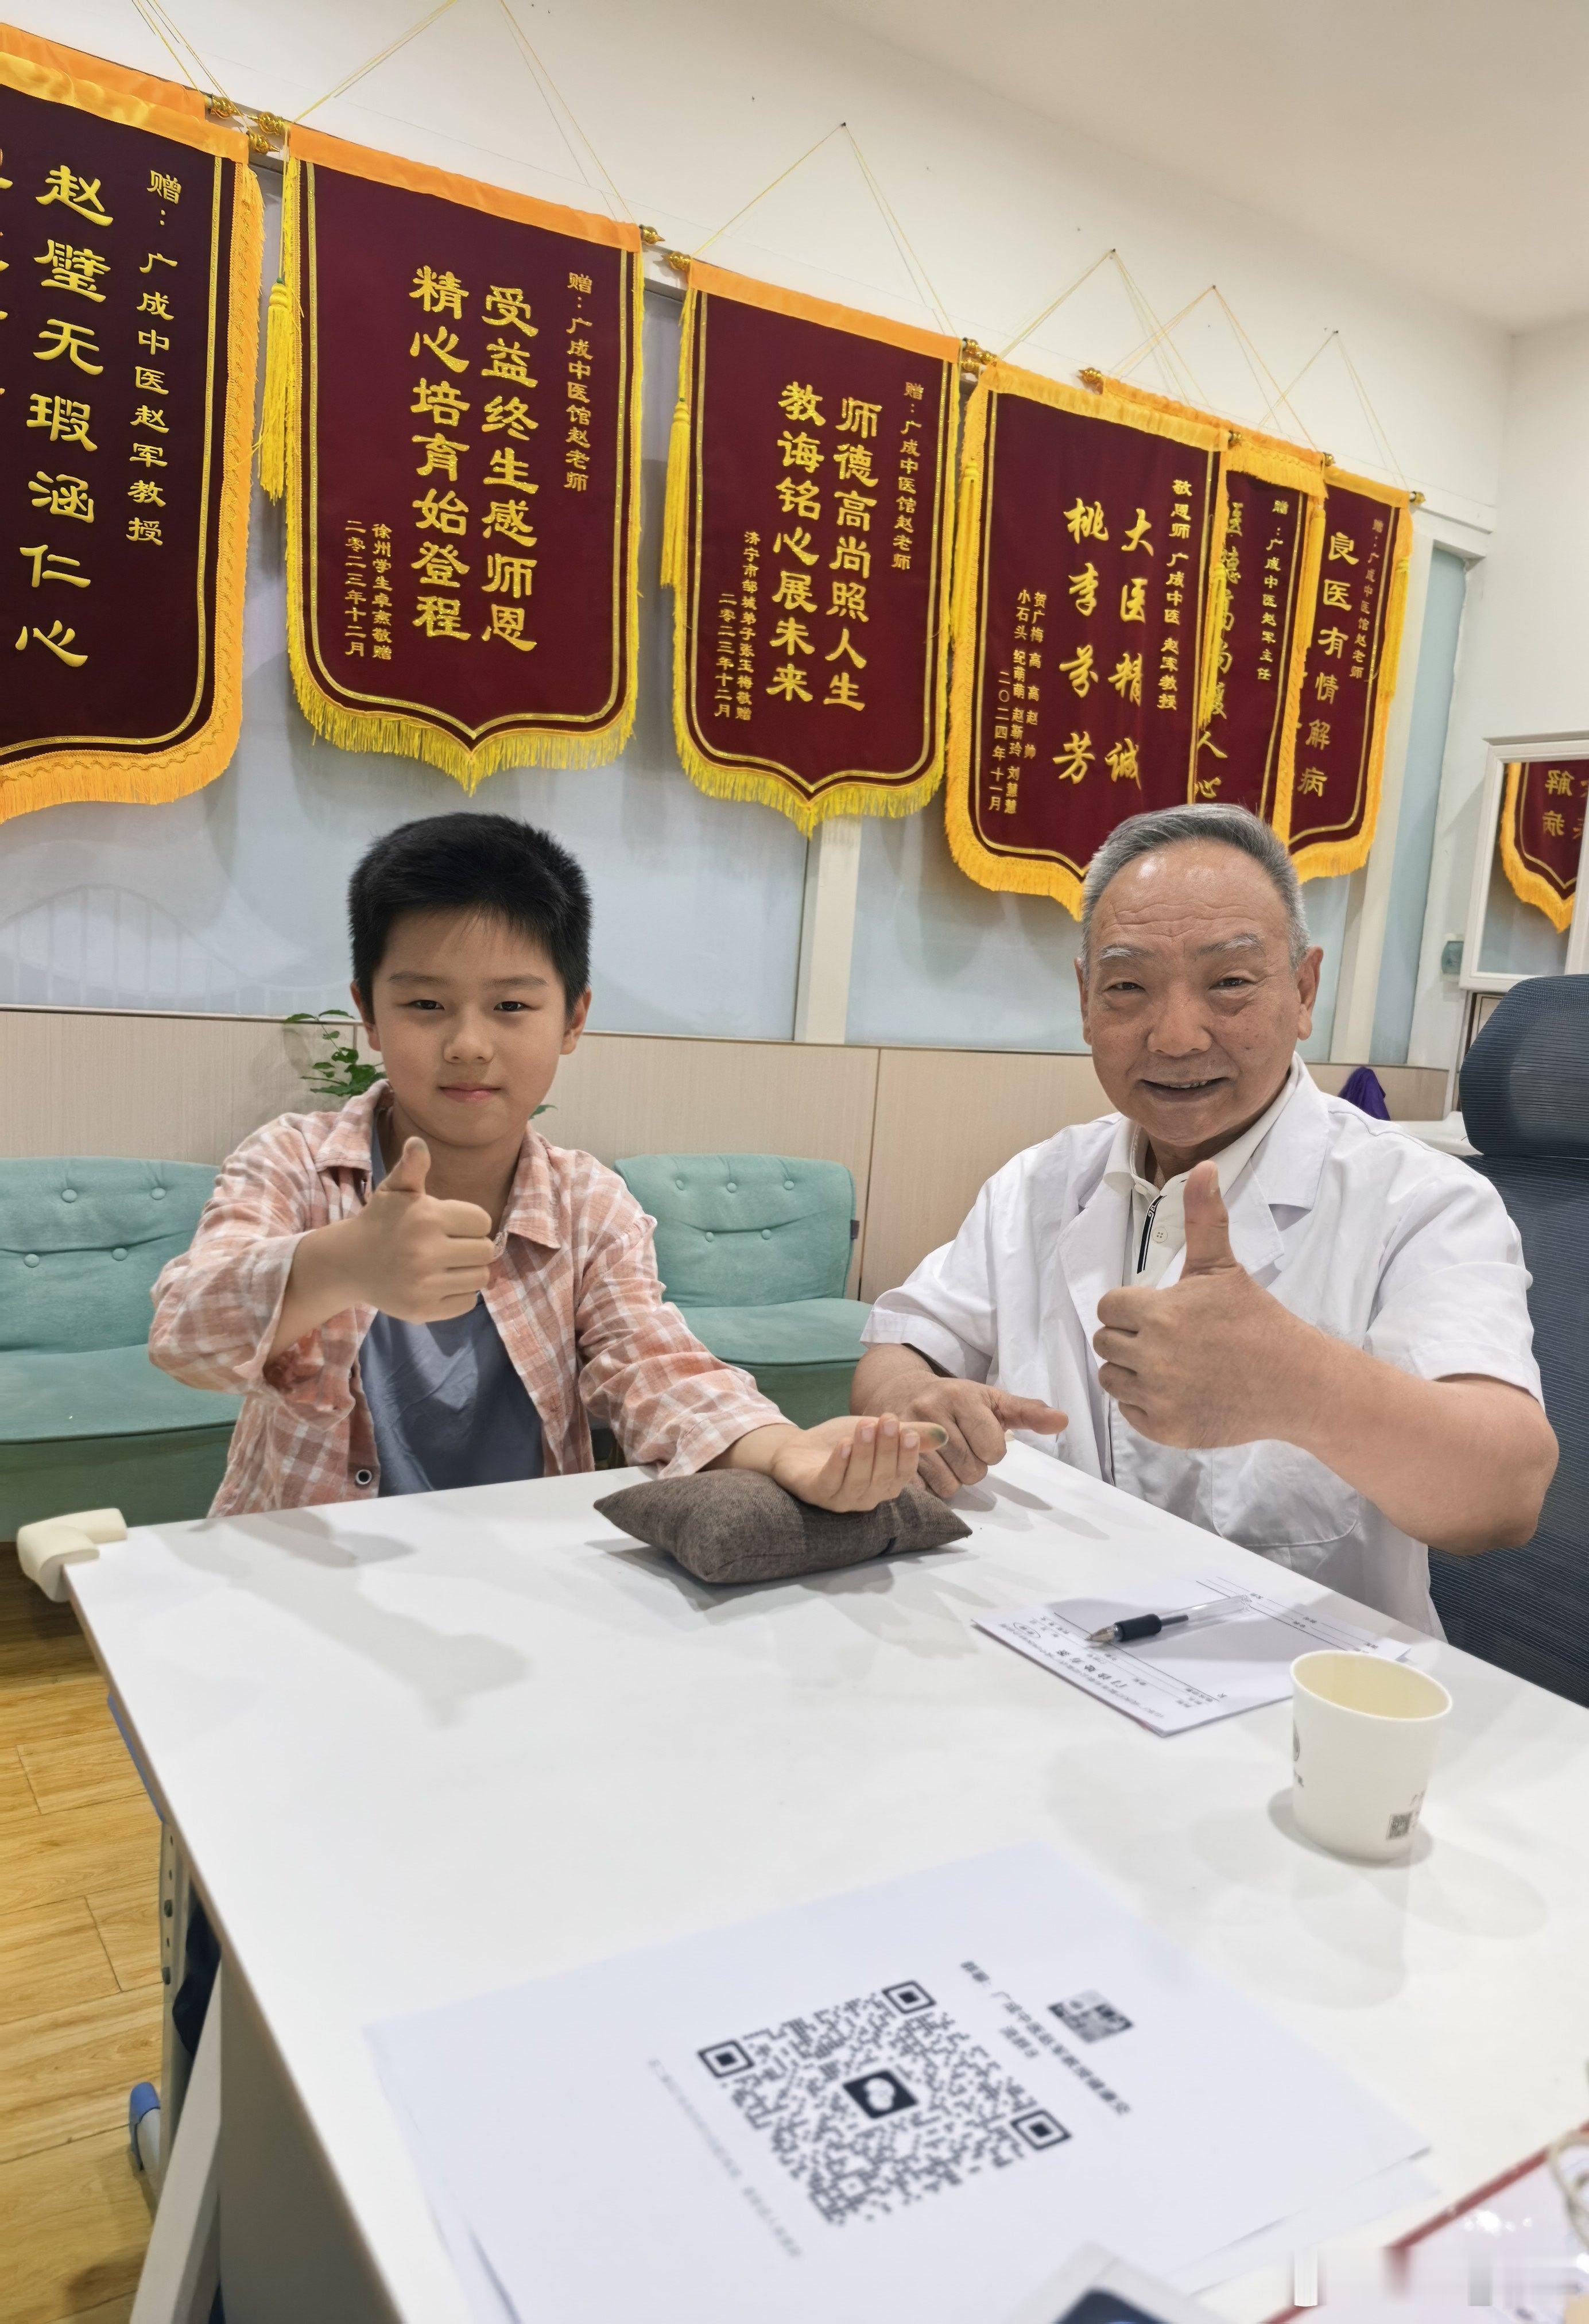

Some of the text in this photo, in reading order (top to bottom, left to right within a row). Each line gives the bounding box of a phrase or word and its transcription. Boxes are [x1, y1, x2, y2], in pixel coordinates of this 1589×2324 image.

[15, 165, 113, 667] 赵璧无瑕涵仁心
[409, 266, 471, 640] 精心培育始登程
[481, 285, 538, 651] 受益终生感师恩
[766, 382, 825, 702] 教诲铭心展未来
[823, 397, 882, 711] 师德高尚照人生
[345, 521, 366, 656] 二零二三年十二月
[715, 594, 737, 717] 二零二三年十二月
[1014, 589, 1030, 640] 小石头
[1053, 498, 1109, 784] 桃李芬芳
[1104, 508, 1153, 788] 大医精诚
[1157, 479, 1192, 710] 敬恩师 广成中医 赵军教授
[1299, 532, 1358, 796] 良医有情解病
